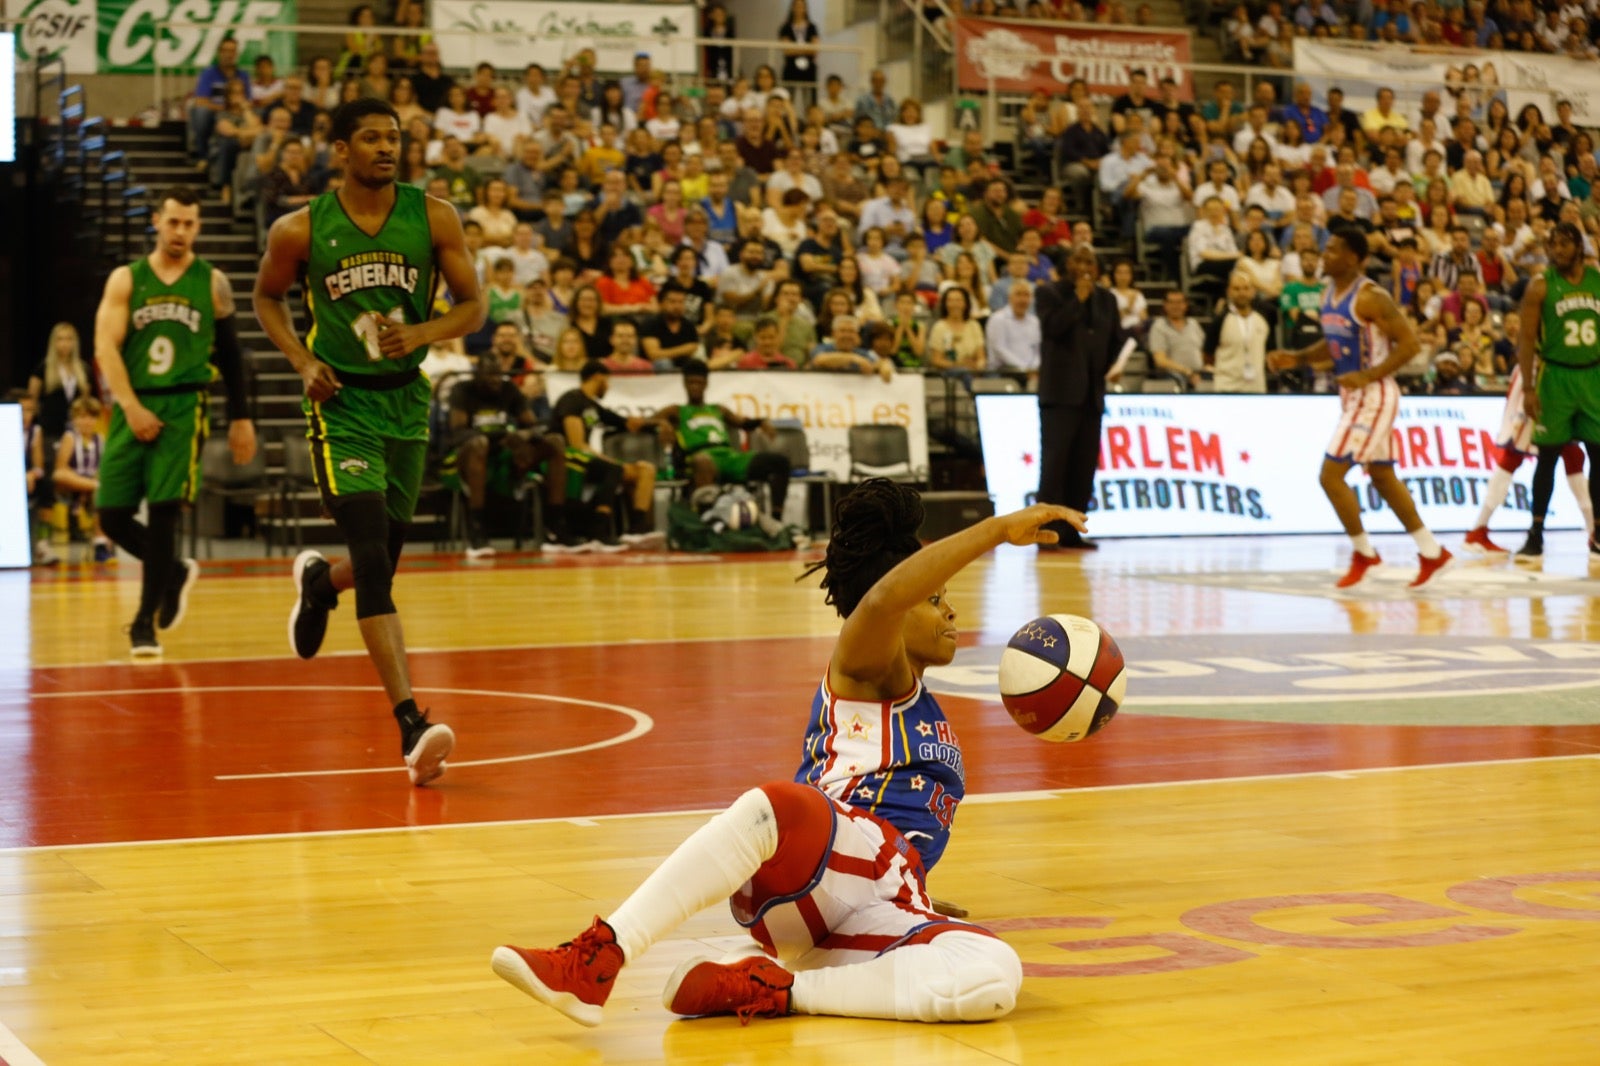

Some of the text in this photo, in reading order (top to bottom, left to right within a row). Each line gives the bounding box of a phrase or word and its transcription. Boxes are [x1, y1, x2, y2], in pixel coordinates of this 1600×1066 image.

[26, 13, 91, 39] CSIF
[106, 0, 284, 67] CSIF
[959, 110, 977, 128] A
[325, 263, 418, 301] GENERALS
[1564, 319, 1597, 346] 26
[148, 335, 175, 375] 9
[1098, 424, 1226, 477] RLEM
